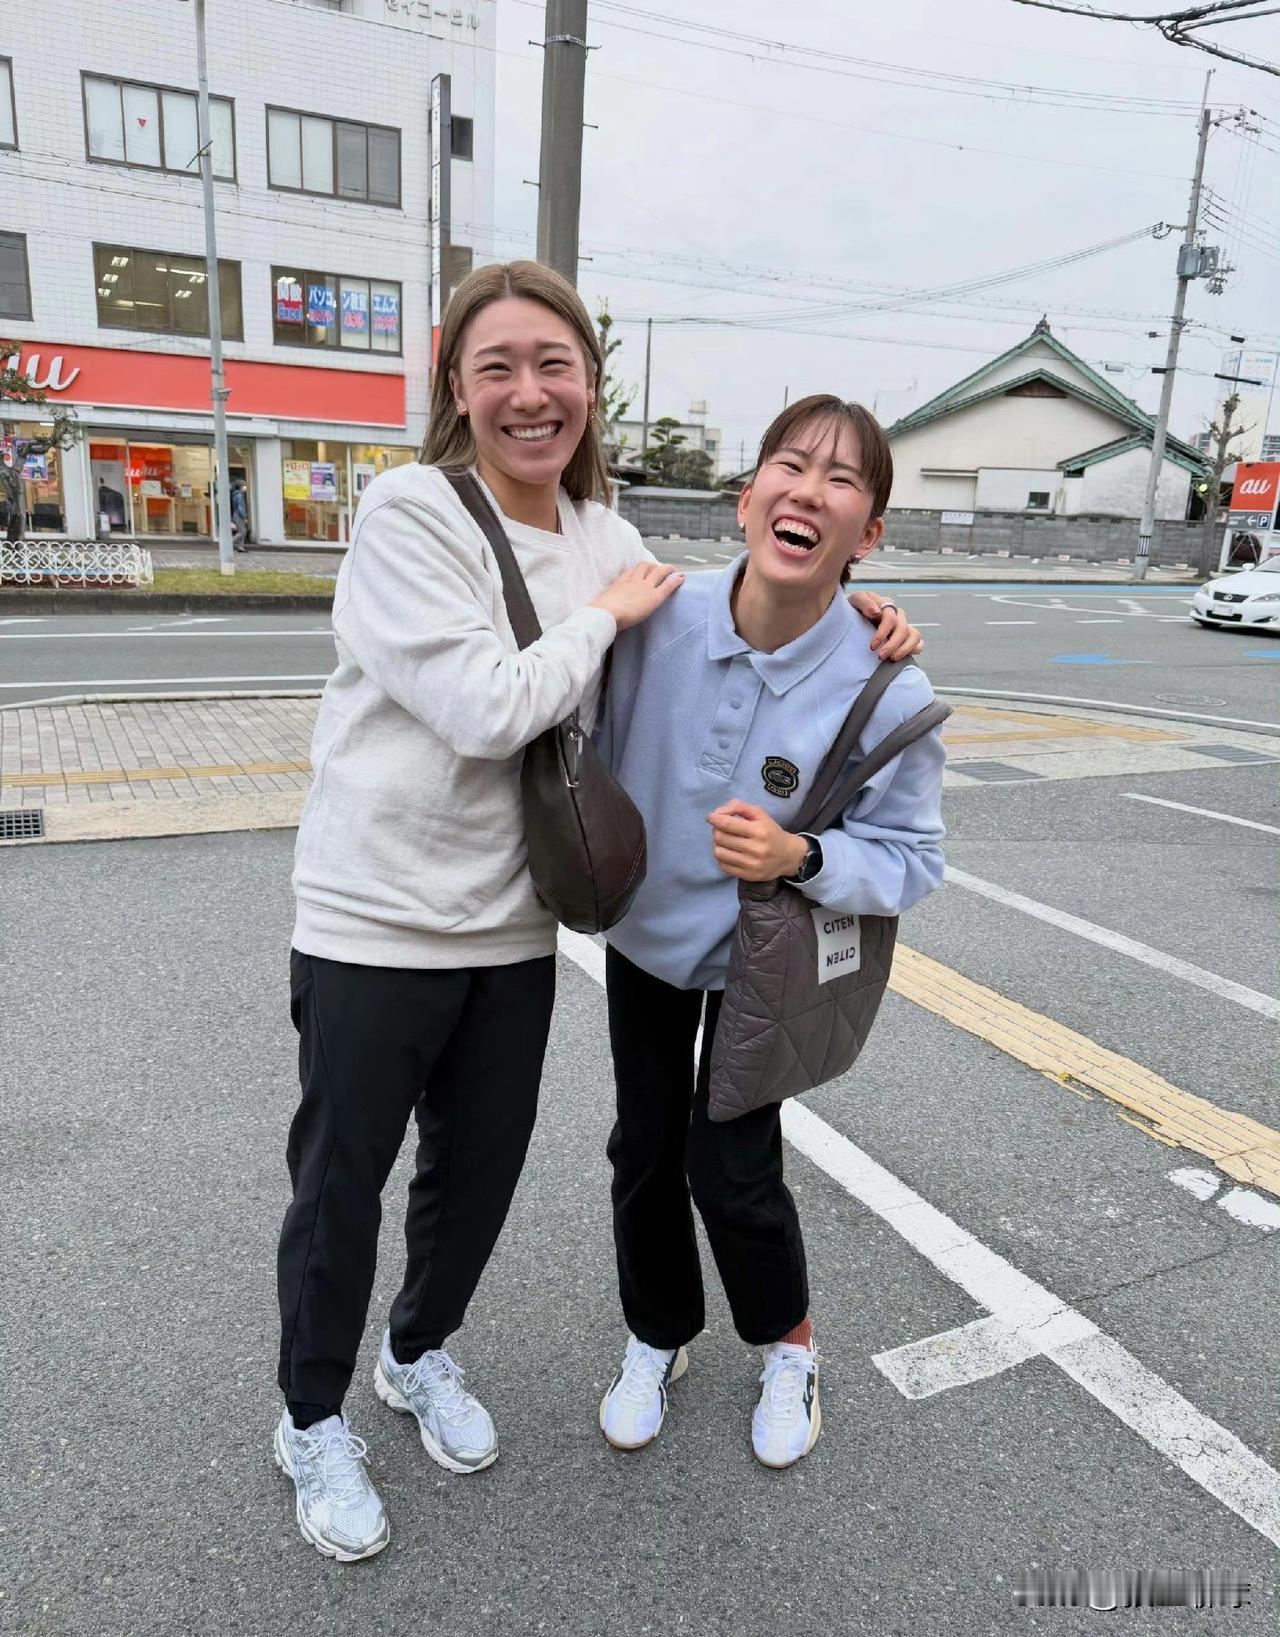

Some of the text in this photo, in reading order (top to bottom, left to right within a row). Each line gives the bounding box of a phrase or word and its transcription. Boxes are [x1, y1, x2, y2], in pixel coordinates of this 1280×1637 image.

[1240, 479, 1271, 494] au
[1260, 516, 1268, 526] P
[823, 914, 855, 934] CITEN
[826, 947, 856, 967] CITEN
